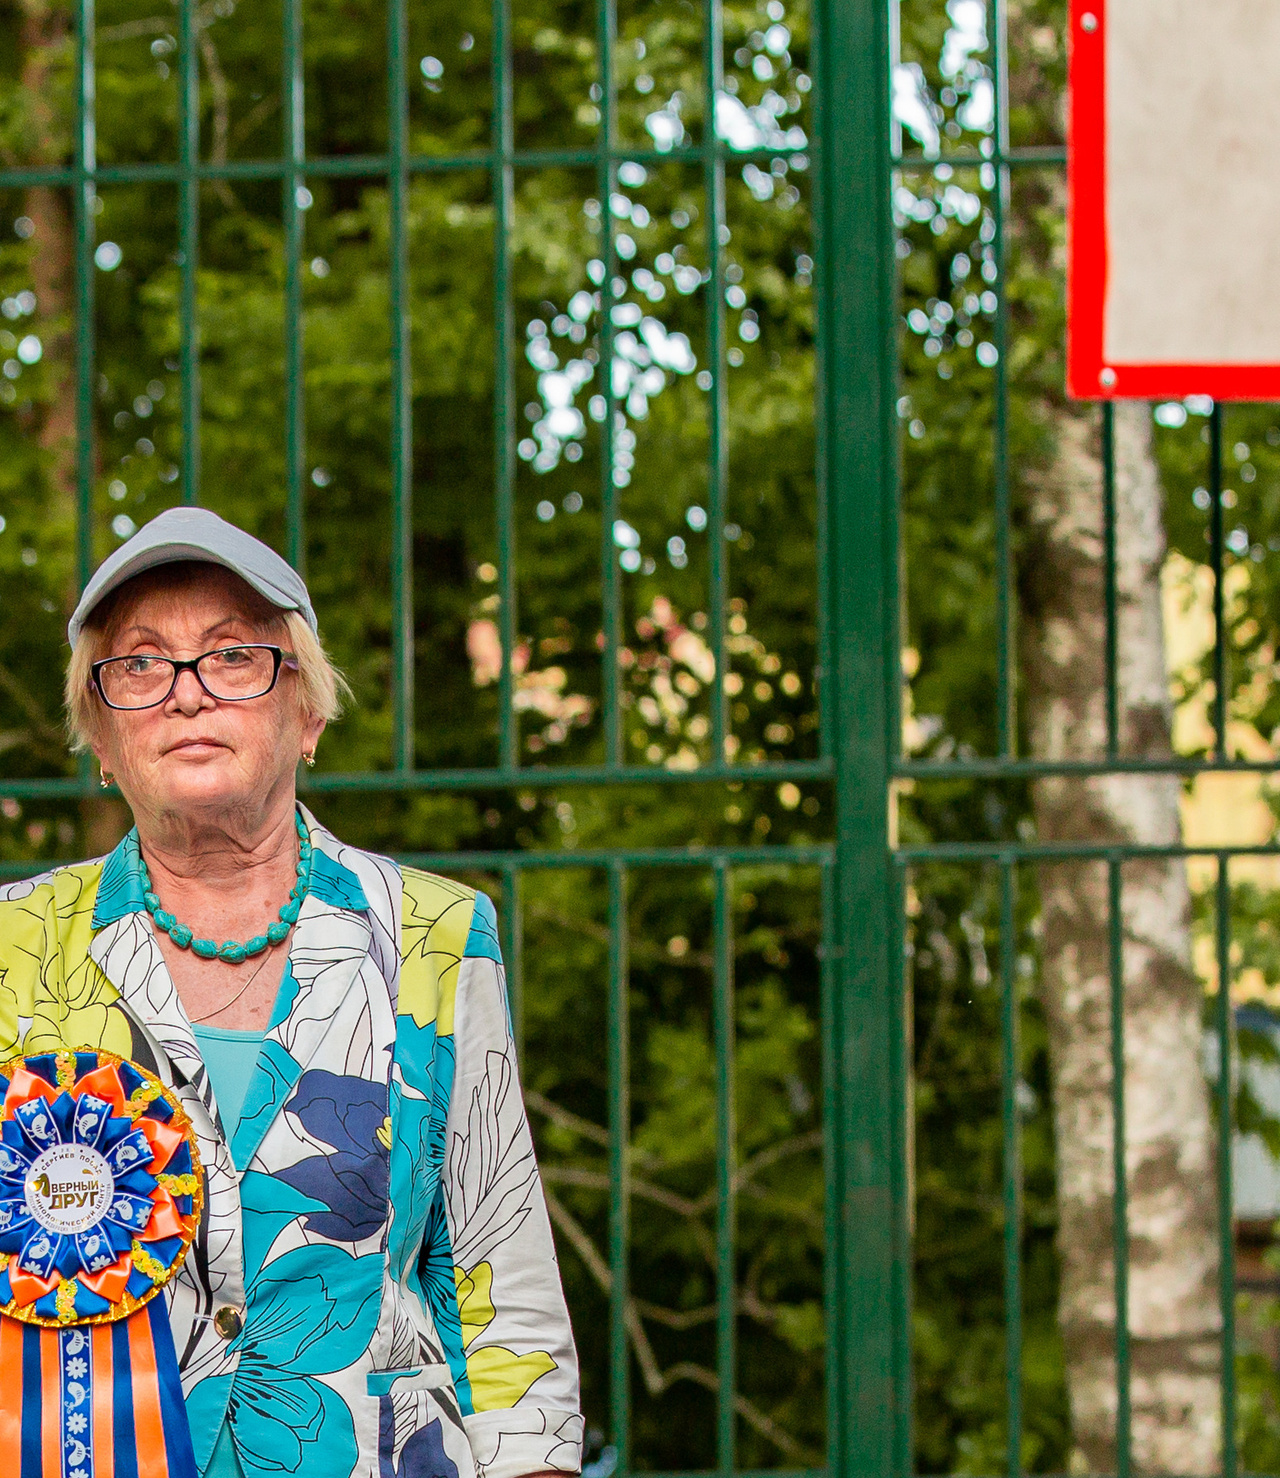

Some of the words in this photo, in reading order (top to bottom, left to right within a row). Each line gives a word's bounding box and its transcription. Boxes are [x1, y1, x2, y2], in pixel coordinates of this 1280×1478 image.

[41, 1153, 75, 1171] СЕРГИЕВ
[79, 1154, 102, 1175] ПОСАД
[51, 1180, 99, 1194] ВЕРНЫЙ
[95, 1183, 106, 1210] ЦЕНТР
[48, 1191, 99, 1210] ДРУГ
